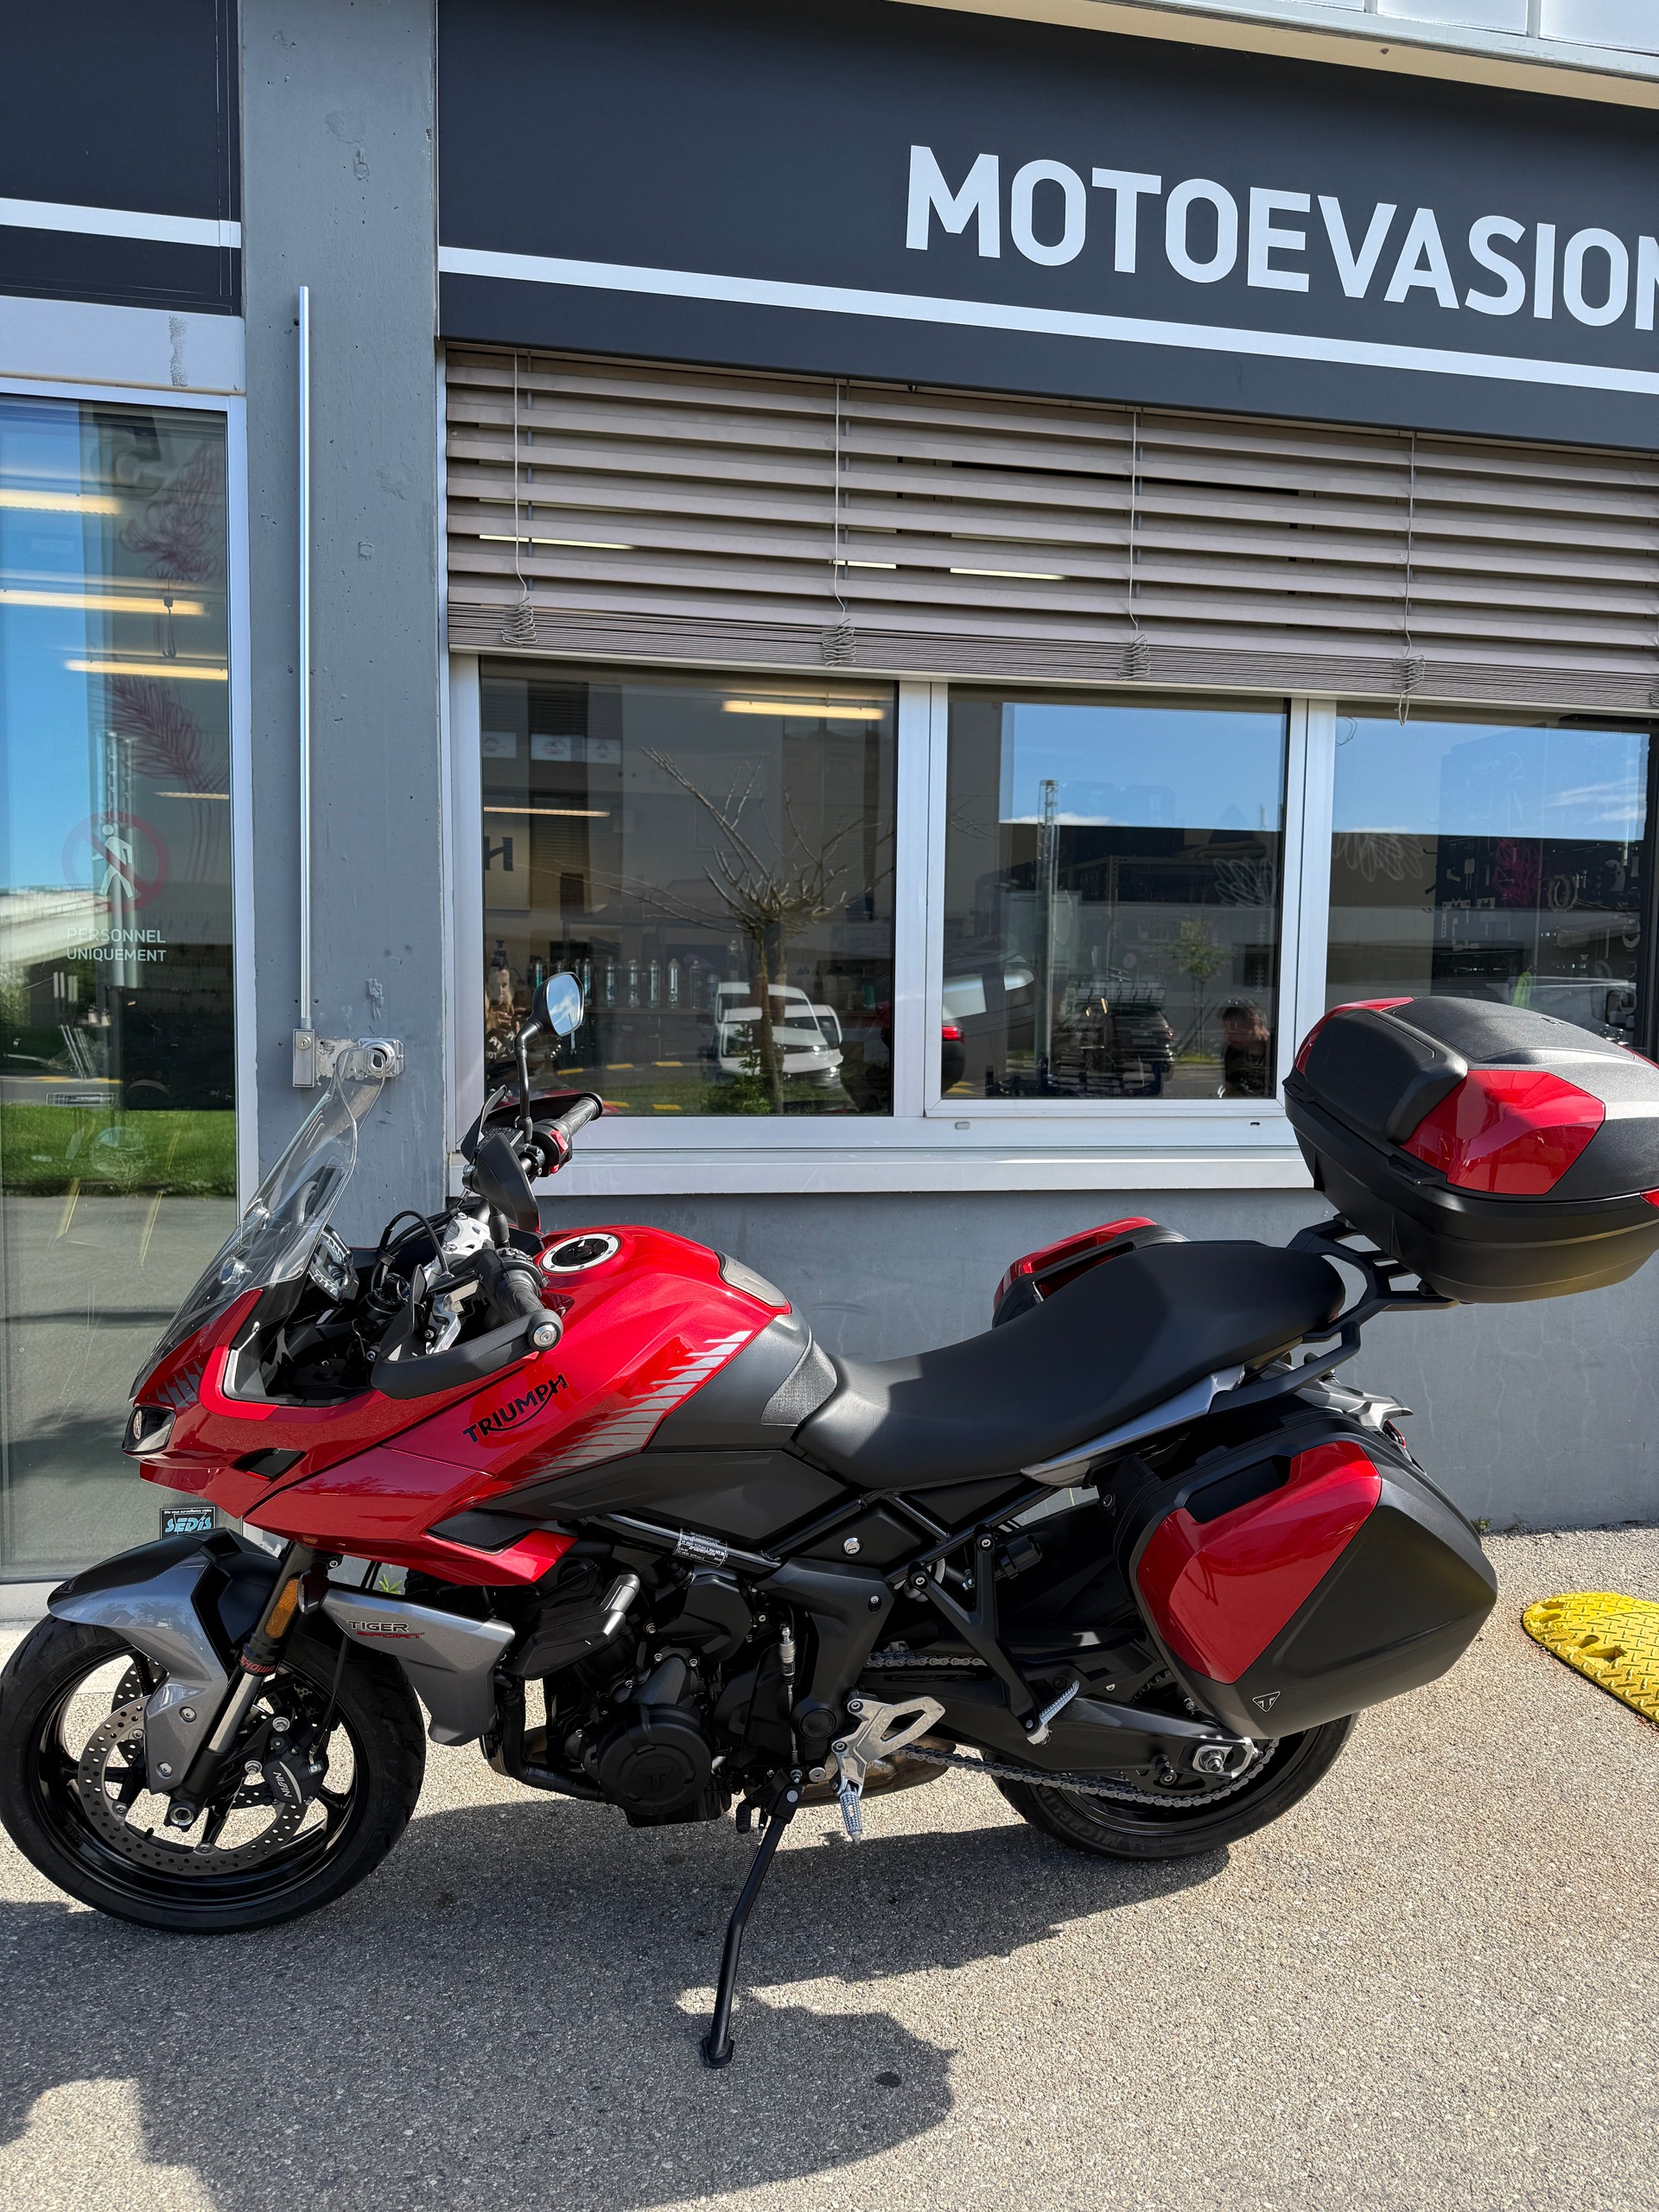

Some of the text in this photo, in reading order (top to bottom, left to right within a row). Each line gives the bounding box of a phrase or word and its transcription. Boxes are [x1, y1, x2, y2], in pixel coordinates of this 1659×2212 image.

[67, 927, 167, 944] PERSONNEL
[67, 947, 167, 963] UNIQUEMENT
[462, 1373, 569, 1443] TRIUMPH
[346, 1619, 410, 1632] TIGER
[357, 1630, 425, 1639] SPORT
[239, 1655, 276, 1674] SHOWA
